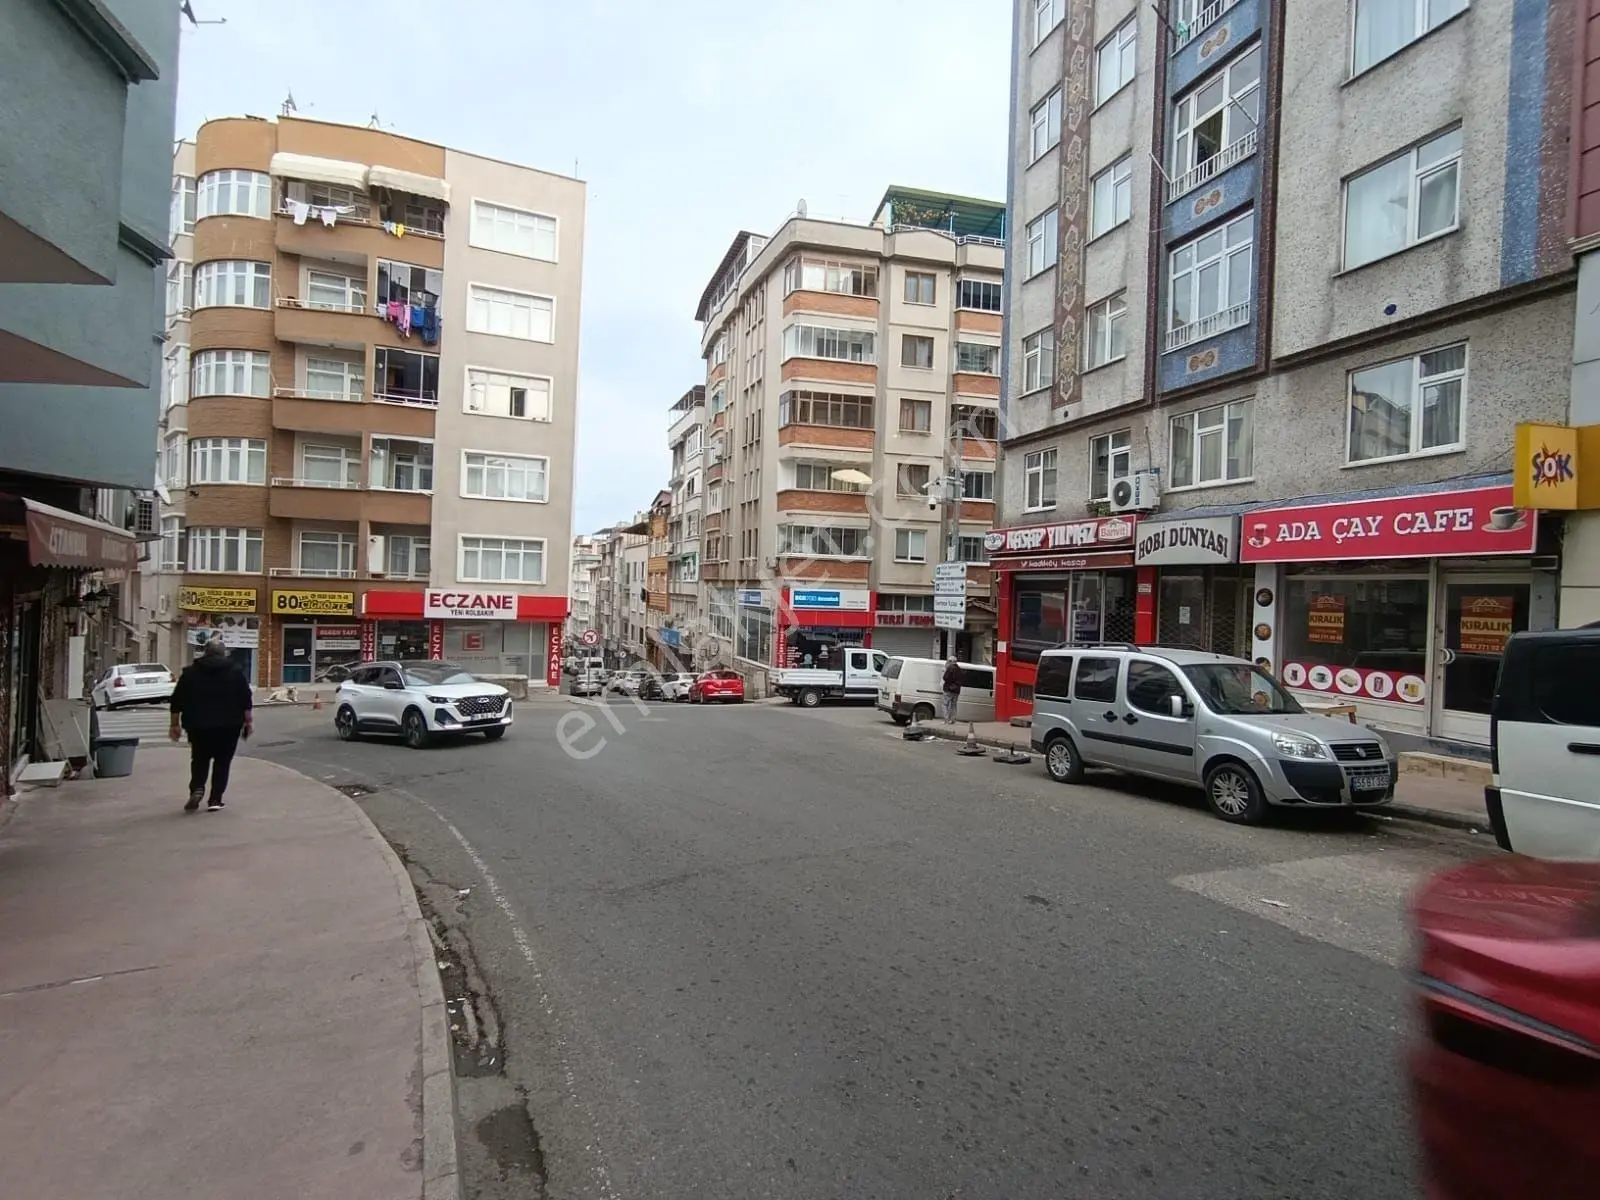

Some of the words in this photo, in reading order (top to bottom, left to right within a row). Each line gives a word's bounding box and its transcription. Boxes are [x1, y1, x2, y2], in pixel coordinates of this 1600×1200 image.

[1006, 528, 1046, 550] KASAP
[1047, 522, 1098, 548] YILMAZ
[1276, 521, 1322, 542] ADA
[1332, 515, 1384, 544] ÇAY
[1393, 508, 1474, 534] CAFE
[1138, 525, 1166, 560] HOBİ
[1169, 522, 1229, 558] DÜNYASI
[277, 594, 299, 609] 80
[429, 593, 513, 609] ECZANE
[877, 613, 905, 625] TERZİ
[1462, 620, 1512, 632] KIRALIK
[433, 626, 441, 661] ECZA
[550, 627, 560, 679] ECZANE
